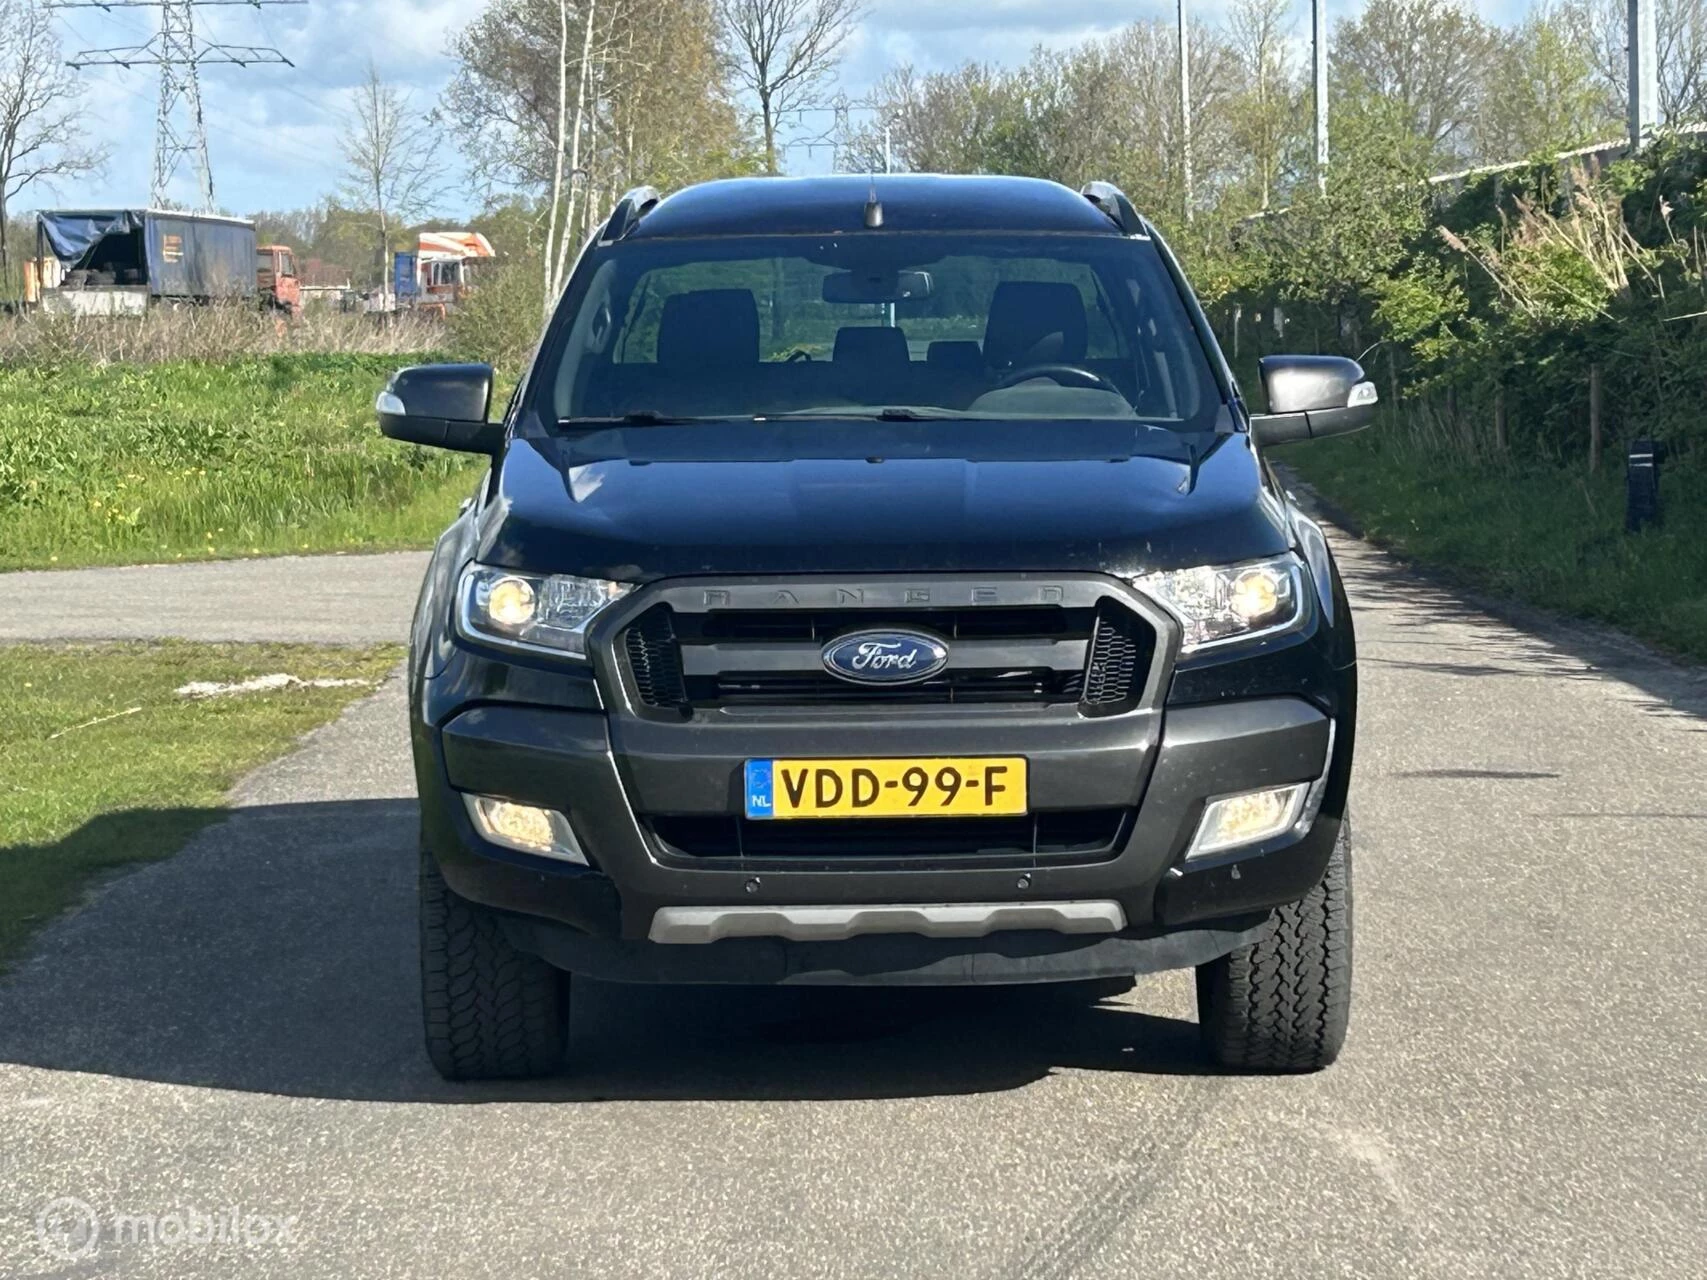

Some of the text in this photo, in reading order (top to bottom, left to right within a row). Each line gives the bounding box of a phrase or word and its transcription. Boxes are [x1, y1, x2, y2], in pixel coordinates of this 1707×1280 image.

[703, 584, 1064, 606] RANGER
[851, 642, 917, 670] Ford
[780, 766, 1008, 809] VDD-99-F
[751, 795, 772, 808] NL
